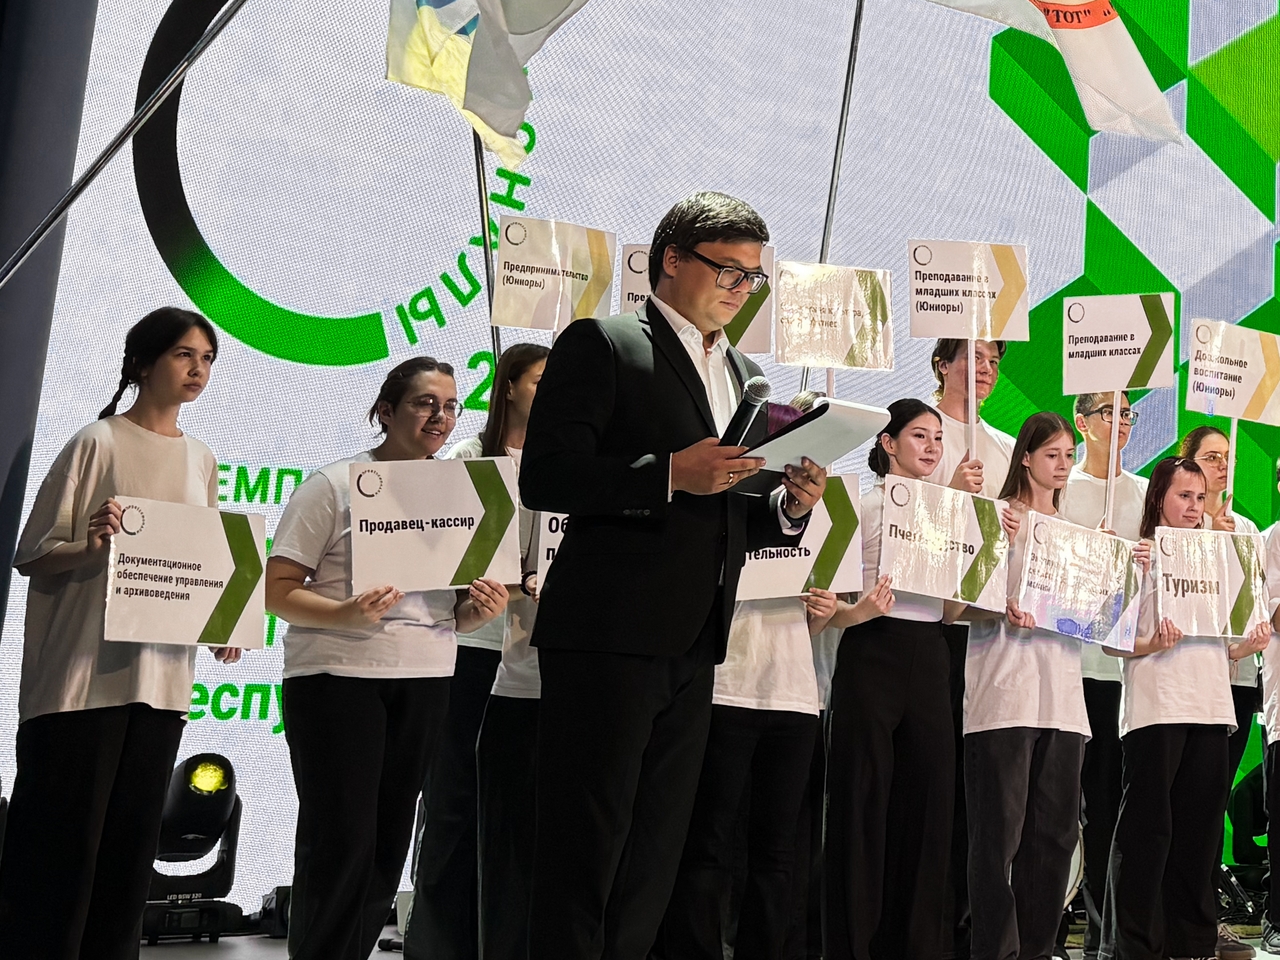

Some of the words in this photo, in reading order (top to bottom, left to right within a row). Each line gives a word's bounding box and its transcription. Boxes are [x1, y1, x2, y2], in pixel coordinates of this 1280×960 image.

[502, 275, 546, 290] (Юниоры)
[915, 287, 960, 299] младших
[915, 301, 964, 314] (Юниоры)
[1068, 332, 1128, 345] Преподавание
[1129, 334, 1135, 342] в
[1068, 348, 1107, 360] младших
[1108, 346, 1141, 357] классах
[1193, 367, 1243, 384] воспитание
[1192, 382, 1235, 400] (Юниоры)
[359, 516, 475, 535] Продавец-кассир
[117, 553, 202, 572] Документационное
[117, 570, 174, 585] обеспечение
[175, 575, 224, 589] управления
[1163, 572, 1220, 597] Туризм
[115, 586, 121, 595] и
[123, 586, 190, 601] архивоведения
